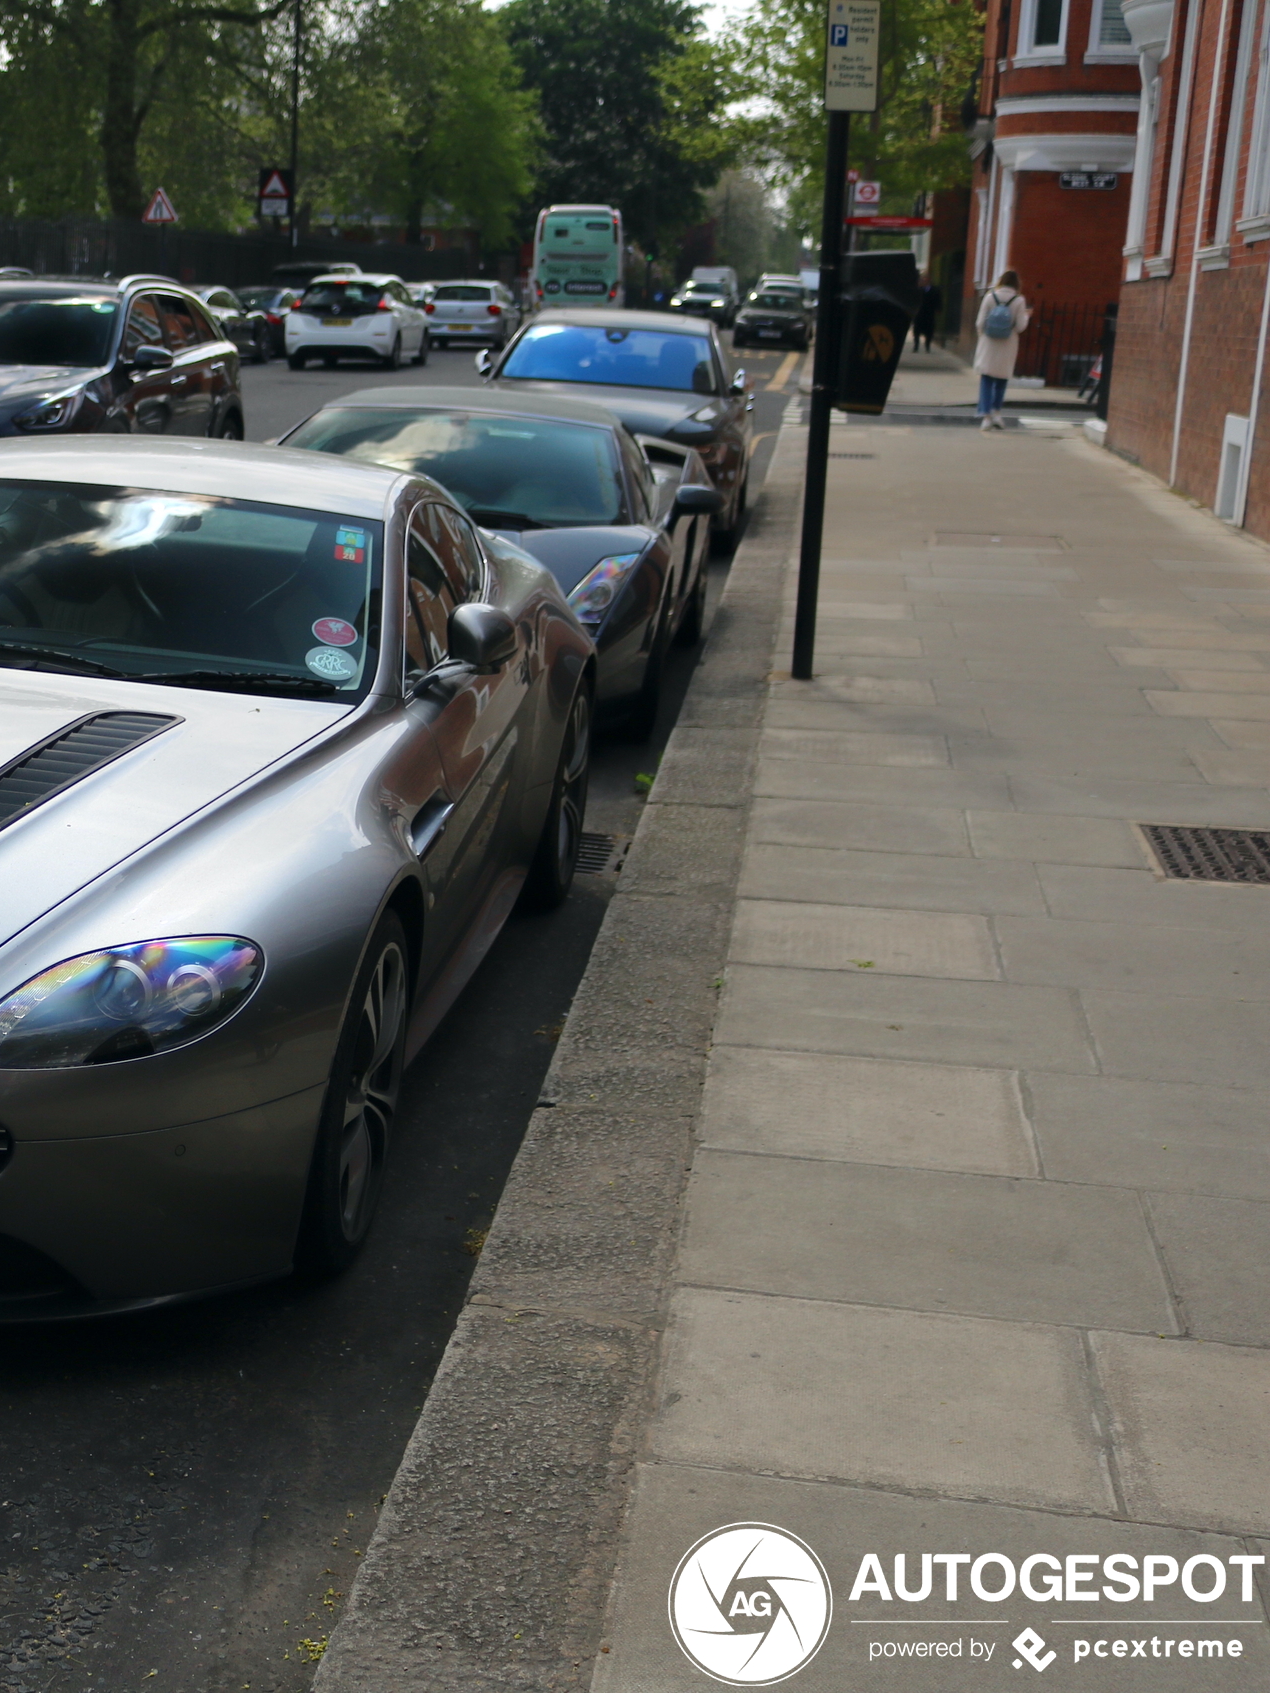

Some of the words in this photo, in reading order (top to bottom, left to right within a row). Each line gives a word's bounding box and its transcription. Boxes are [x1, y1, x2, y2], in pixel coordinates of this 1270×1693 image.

[848, 6, 878, 14] Resident
[850, 26, 876, 34] holders
[834, 26, 846, 45] P
[855, 35, 870, 44] only
